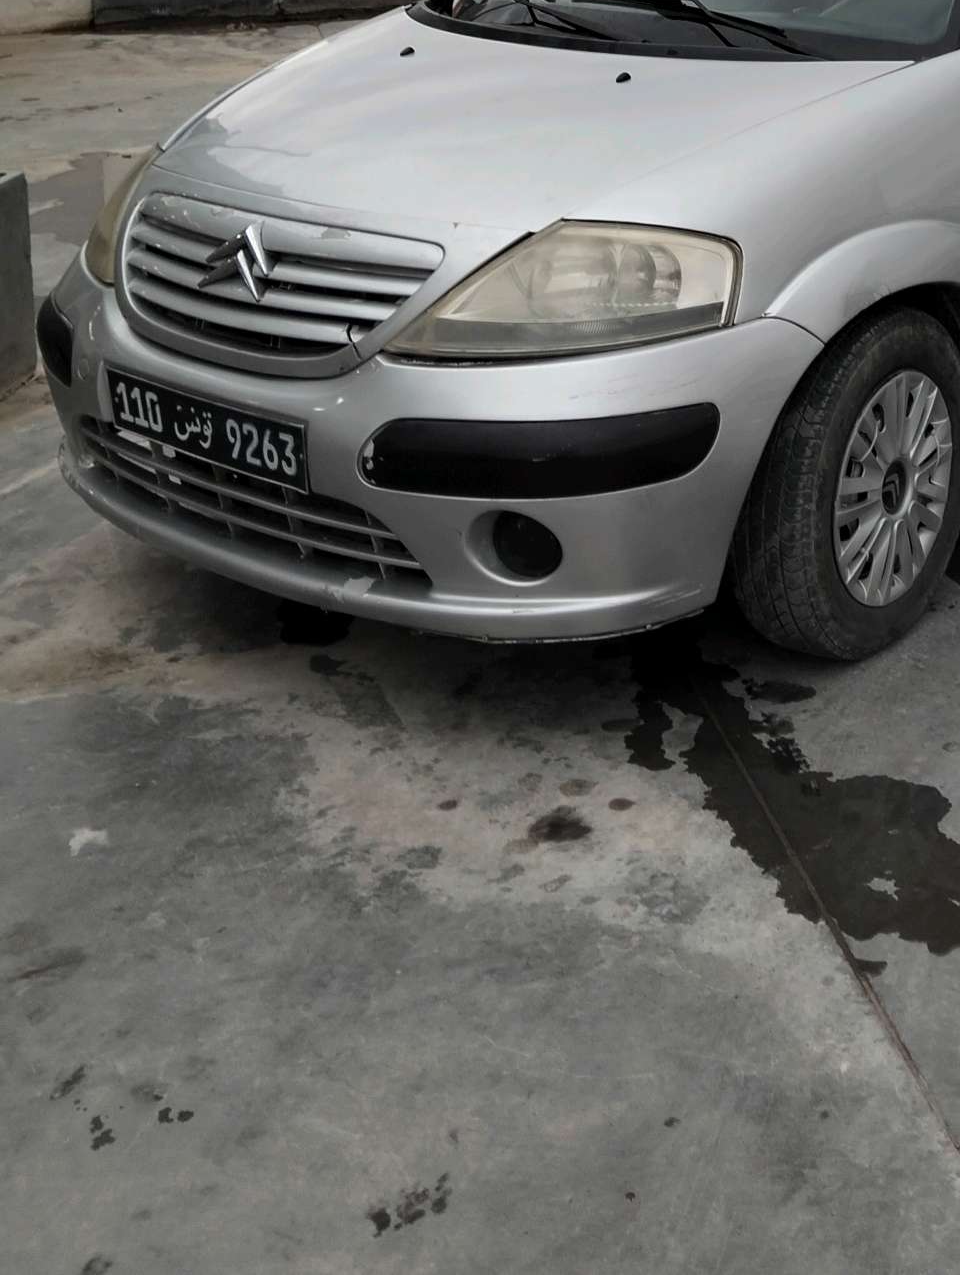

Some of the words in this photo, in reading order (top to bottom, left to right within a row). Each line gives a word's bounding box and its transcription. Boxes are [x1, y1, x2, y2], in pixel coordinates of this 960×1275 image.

[116, 381, 163, 433] 110
[174, 405, 214, 450] تونس
[226, 418, 298, 476] 9263
